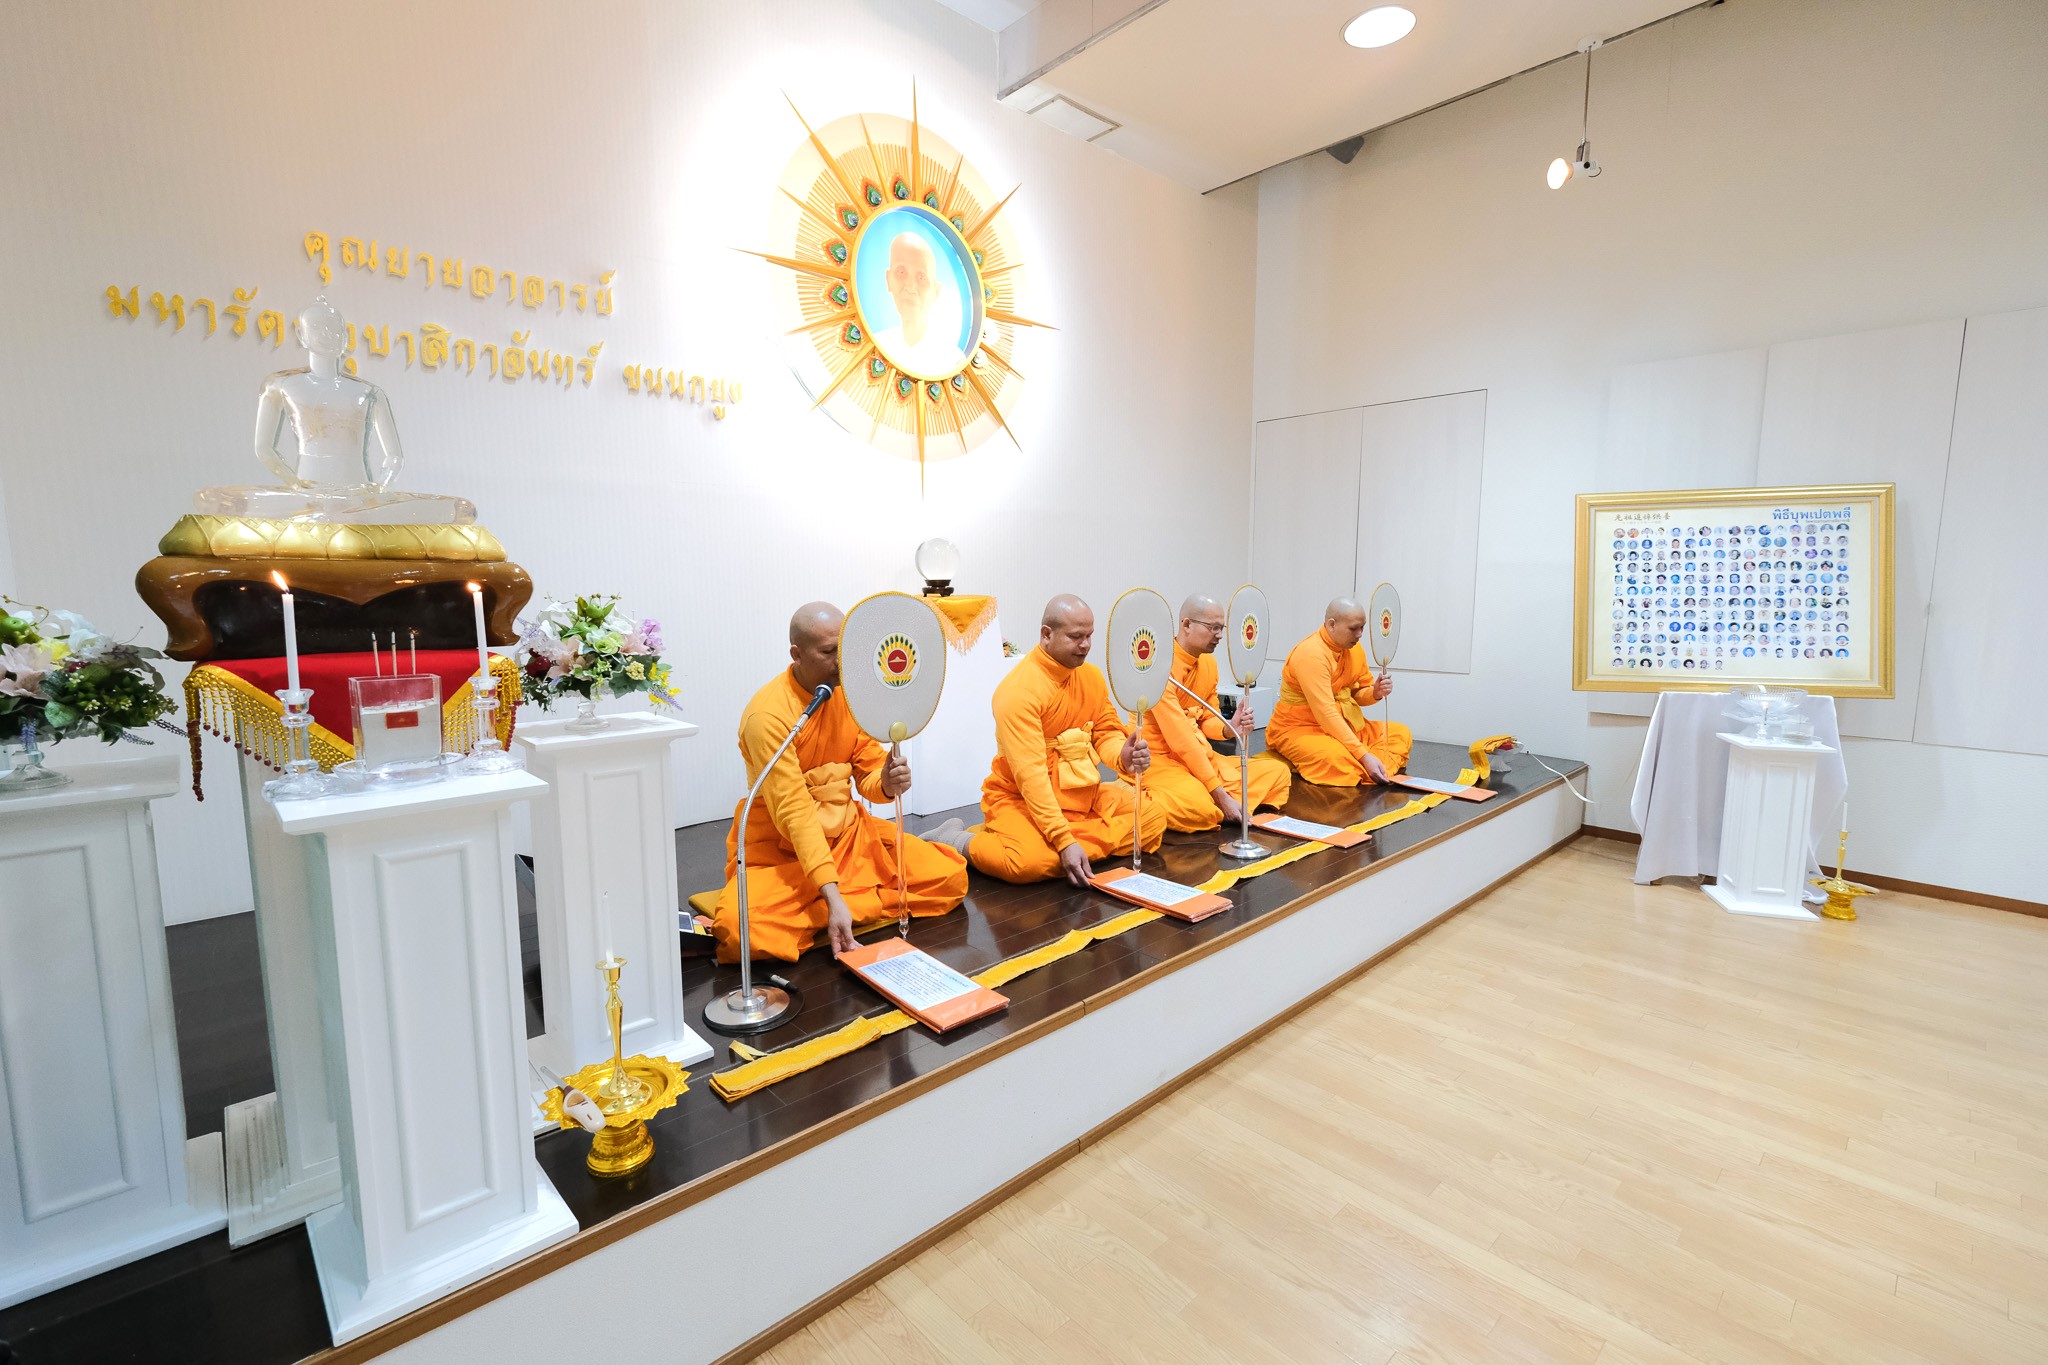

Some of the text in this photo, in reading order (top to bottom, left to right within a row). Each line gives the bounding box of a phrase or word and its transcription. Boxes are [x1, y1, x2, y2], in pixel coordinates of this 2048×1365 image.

[303, 230, 617, 316] คุณยายอาจารย์
[105, 284, 605, 386] มหารัตุบาสิกาจันทร์
[1772, 506, 1851, 523] พิธีบุพเปตพลี
